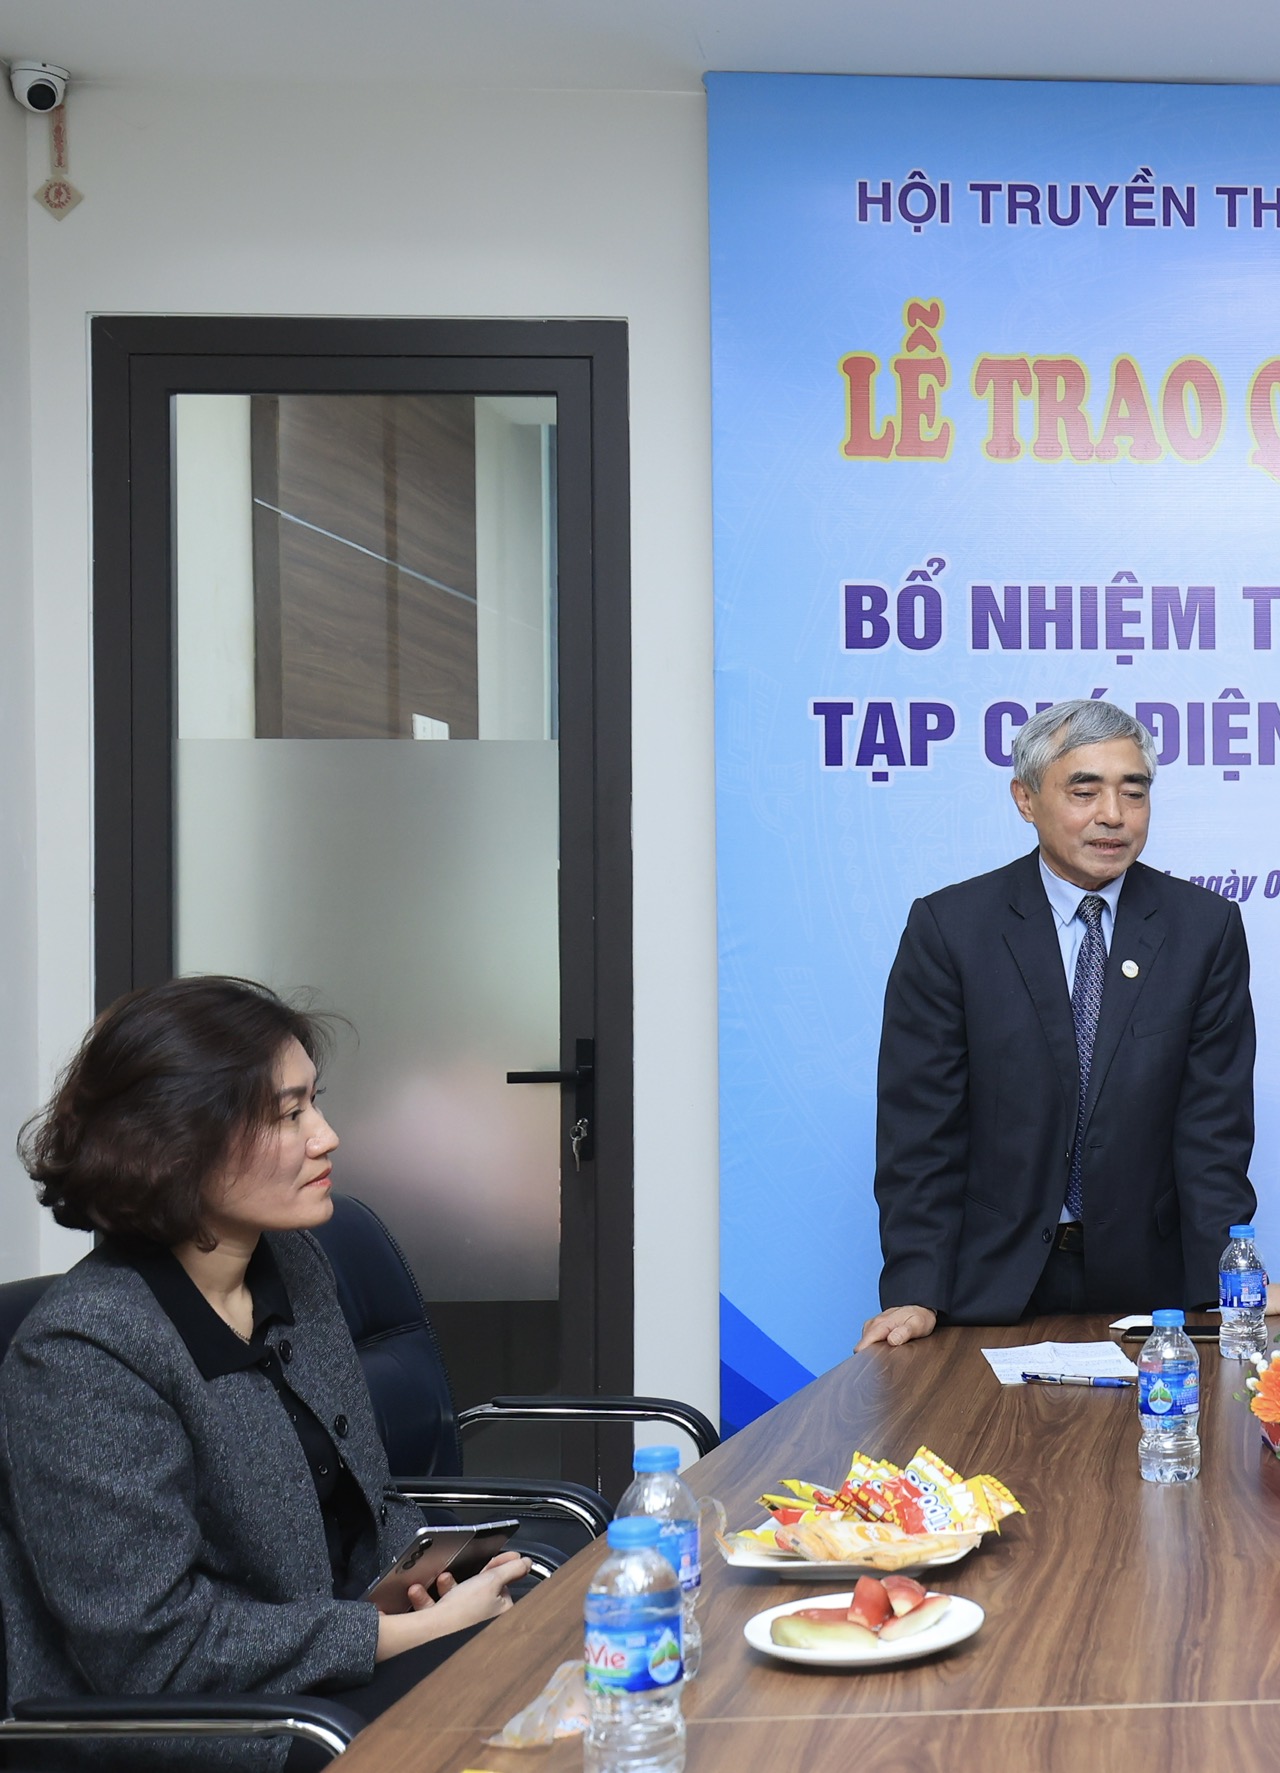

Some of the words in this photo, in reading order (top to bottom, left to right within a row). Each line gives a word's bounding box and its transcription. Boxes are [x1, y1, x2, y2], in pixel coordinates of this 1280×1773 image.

[858, 171, 950, 232] HỘI
[969, 167, 1196, 227] TRUYỀN
[839, 297, 953, 462] LỄ
[971, 353, 1225, 463] TRAO
[844, 557, 946, 651] BỔ
[971, 571, 1216, 665] NHIỆM
[812, 701, 956, 782] TẠP
